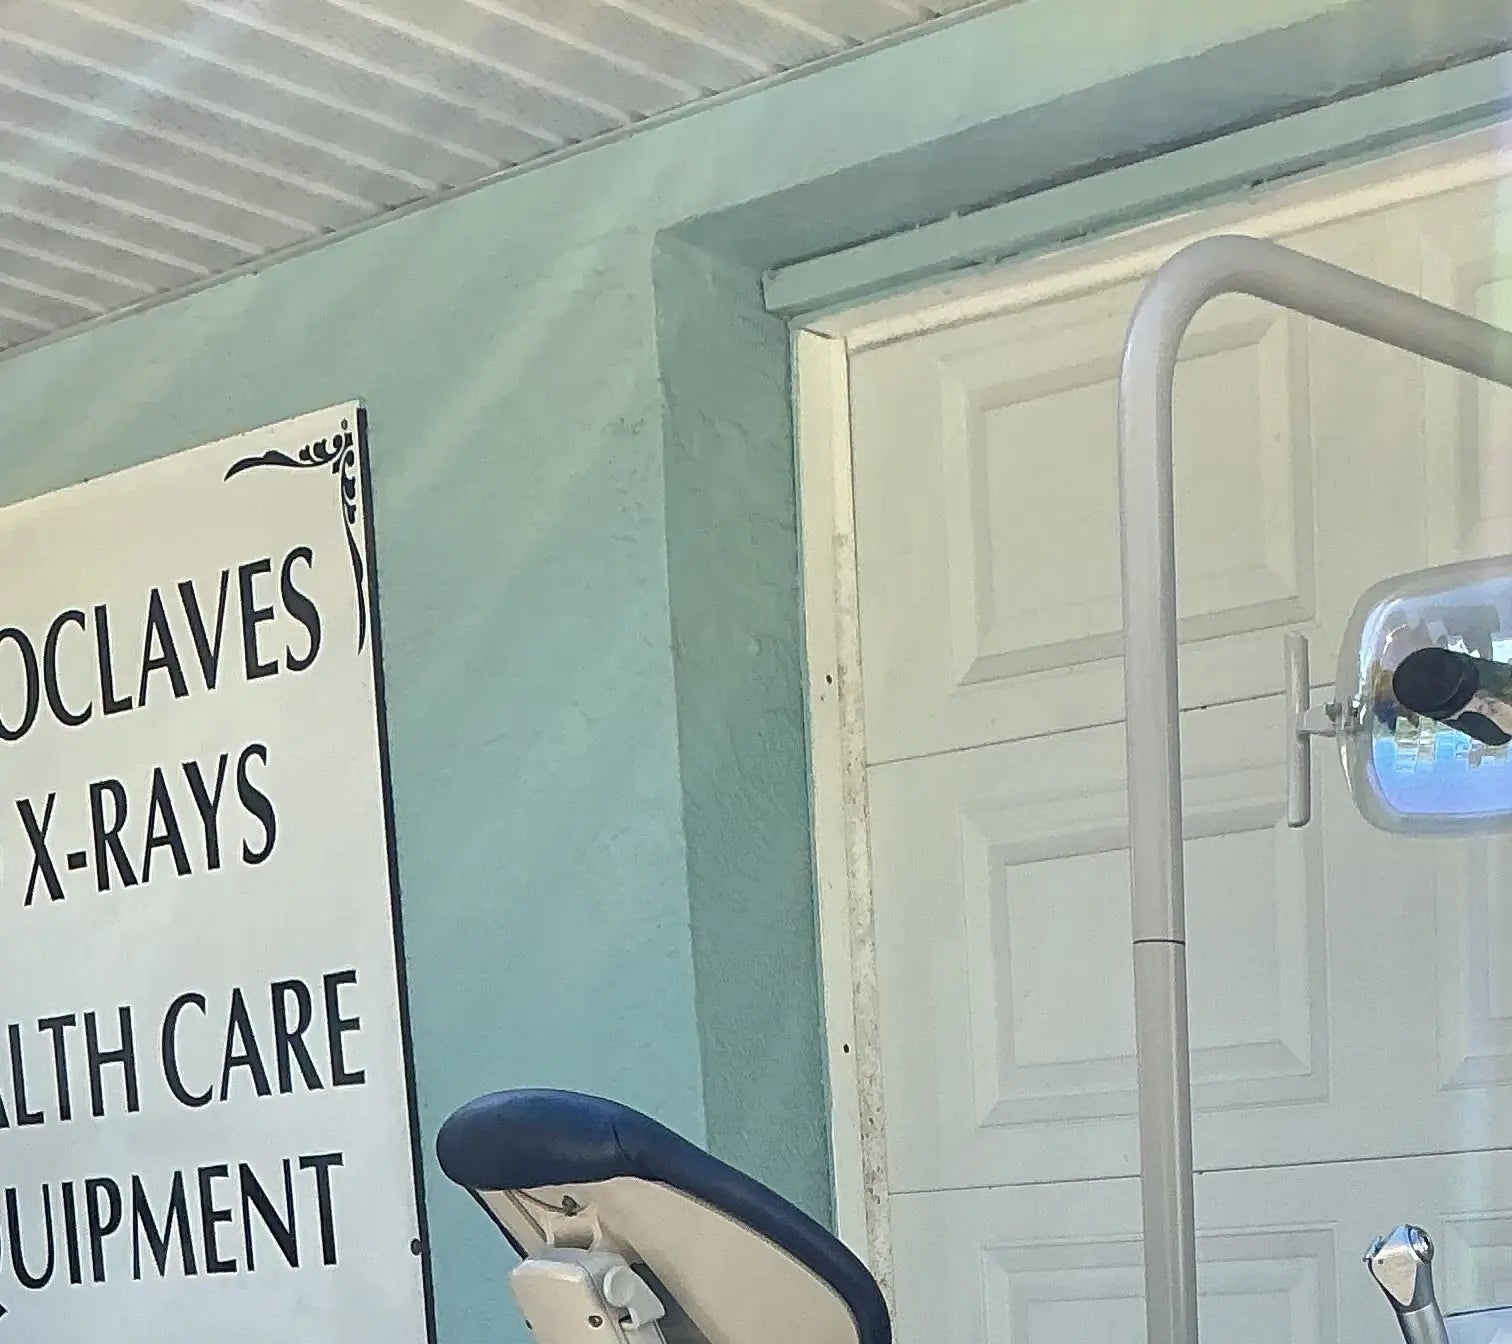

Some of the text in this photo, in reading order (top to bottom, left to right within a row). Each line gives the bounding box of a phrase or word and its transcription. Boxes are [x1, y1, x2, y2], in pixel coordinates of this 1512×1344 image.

[0, 547, 321, 741] OCLAVES
[17, 744, 276, 906] X-RAYS
[0, 969, 365, 1128] LTH CARE
[0, 1154, 344, 1312] UIPMENT
